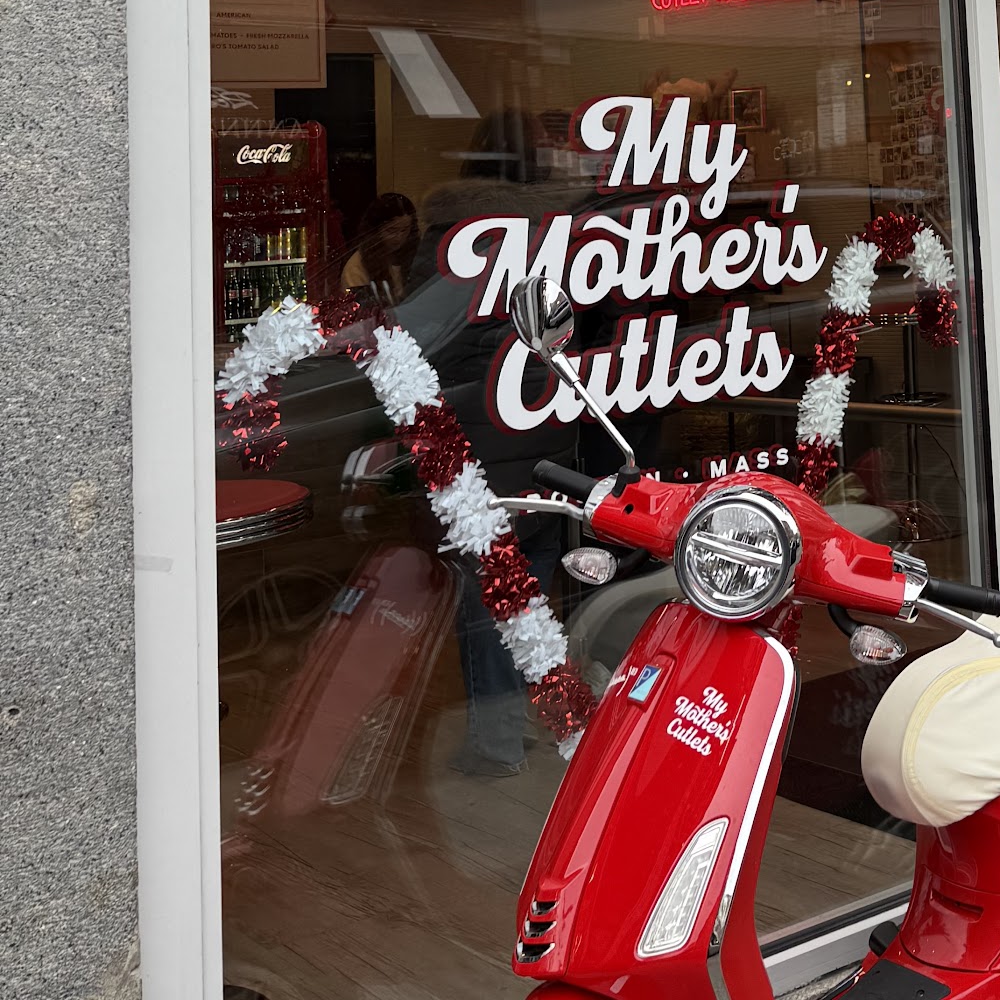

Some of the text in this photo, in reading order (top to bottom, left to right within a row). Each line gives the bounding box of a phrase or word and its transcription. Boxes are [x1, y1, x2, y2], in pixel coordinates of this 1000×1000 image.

[580, 96, 748, 219] My
[447, 184, 828, 317] Mother's
[497, 306, 795, 431] Cutlets
[710, 447, 789, 478] MASS
[673, 696, 732, 745] Mother's
[702, 686, 729, 719] My
[666, 718, 712, 756] Cutlets
